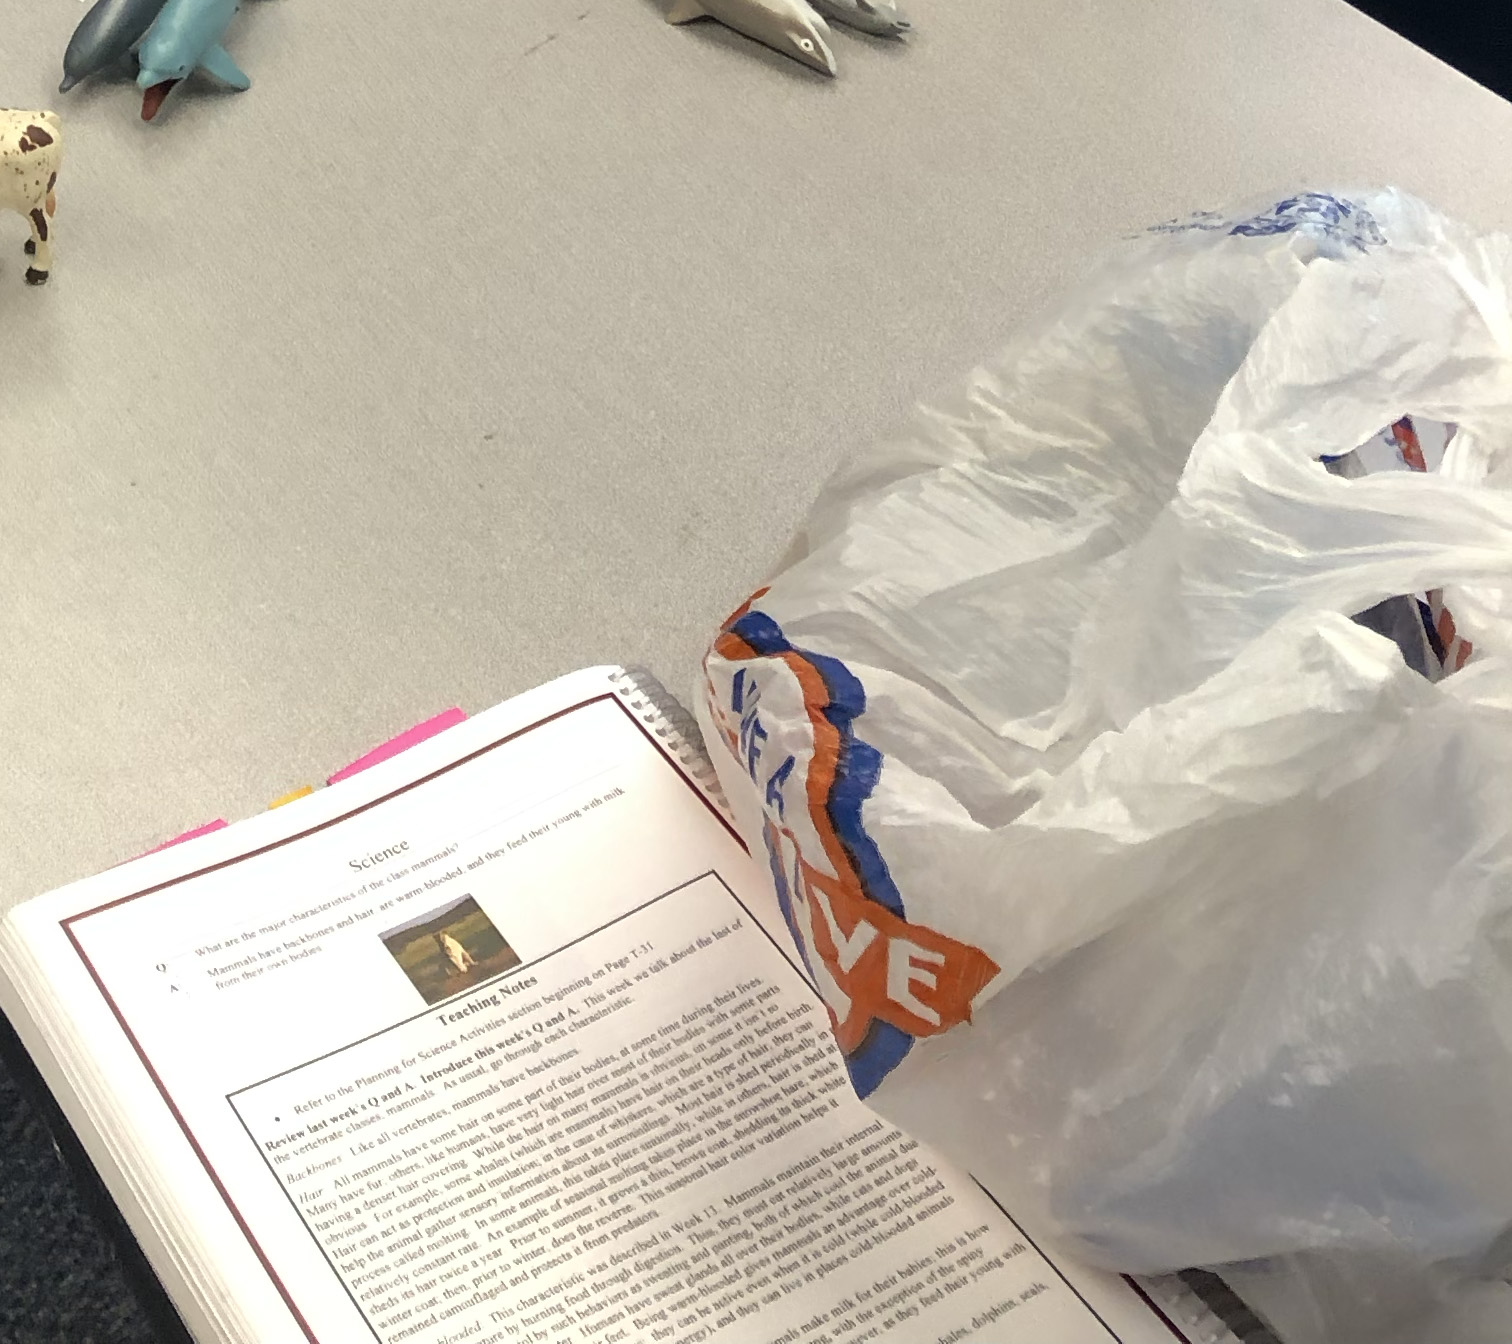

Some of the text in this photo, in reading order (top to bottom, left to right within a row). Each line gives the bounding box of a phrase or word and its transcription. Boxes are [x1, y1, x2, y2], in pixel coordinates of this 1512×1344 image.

[348, 840, 409, 870] Science
[264, 1130, 304, 1151] Review
[306, 1119, 328, 1133] last
[329, 1103, 367, 1123] week's
[367, 1097, 379, 1107] Q
[380, 1085, 402, 1102] and
[419, 1056, 473, 1083] Introduce
[473, 1046, 495, 1059] this
[495, 1029, 532, 1049] week's
[531, 1022, 544, 1033] Q
[544, 1011, 565, 1027] and
[583, 992, 606, 1008] This
[606, 978, 633, 995] week
[633, 970, 649, 982] we
[647, 957, 669, 973] talk
[669, 943, 696, 964] about
[695, 936, 713, 949] the
[711, 925, 731, 940] last
[731, 917, 743, 930] of
[293, 1098, 322, 1114] Refer
[324, 1093, 335, 1102] to
[336, 1085, 354, 1096] the
[354, 1065, 401, 1089] Planning
[401, 1057, 416, 1068] for
[417, 1039, 457, 1059] Science
[459, 1017, 506, 1042] Activities
[507, 1000, 542, 1021] section
[541, 976, 592, 1004] beginning
[591, 968, 605, 979] on
[603, 956, 630, 972] Page
[435, 976, 537, 1025] Teaching Notes
[273, 1153, 290, 1164] the
[292, 1130, 343, 1156] vertebrate
[443, 1079, 457, 1090] As
[489, 1058, 503, 1071] go
[503, 1039, 543, 1062] through
[544, 1027, 568, 1044] each
[333, 1174, 350, 1189] All
[351, 1153, 402, 1180] mammals
[401, 1142, 428, 1158] have
[429, 1129, 457, 1145] some
[456, 1118, 479, 1132] hair
[480, 1111, 494, 1122] on
[495, 1098, 524, 1116] some
[524, 1087, 545, 1104] part
[545, 1078, 557, 1092] of
[557, 1070, 581, 1086] their
[619, 1046, 630, 1057] at
[630, 1033, 657, 1051] some
[657, 1021, 681, 1037] time
[681, 1003, 715, 1024] during
[713, 990, 736, 1007] their
[349, 1141, 375, 1156] Like
[376, 1131, 391, 1144] all
[391, 1108, 451, 1136] vertebrates,
[451, 1083, 500, 1110] mammals
[499, 1072, 525, 1088] have
